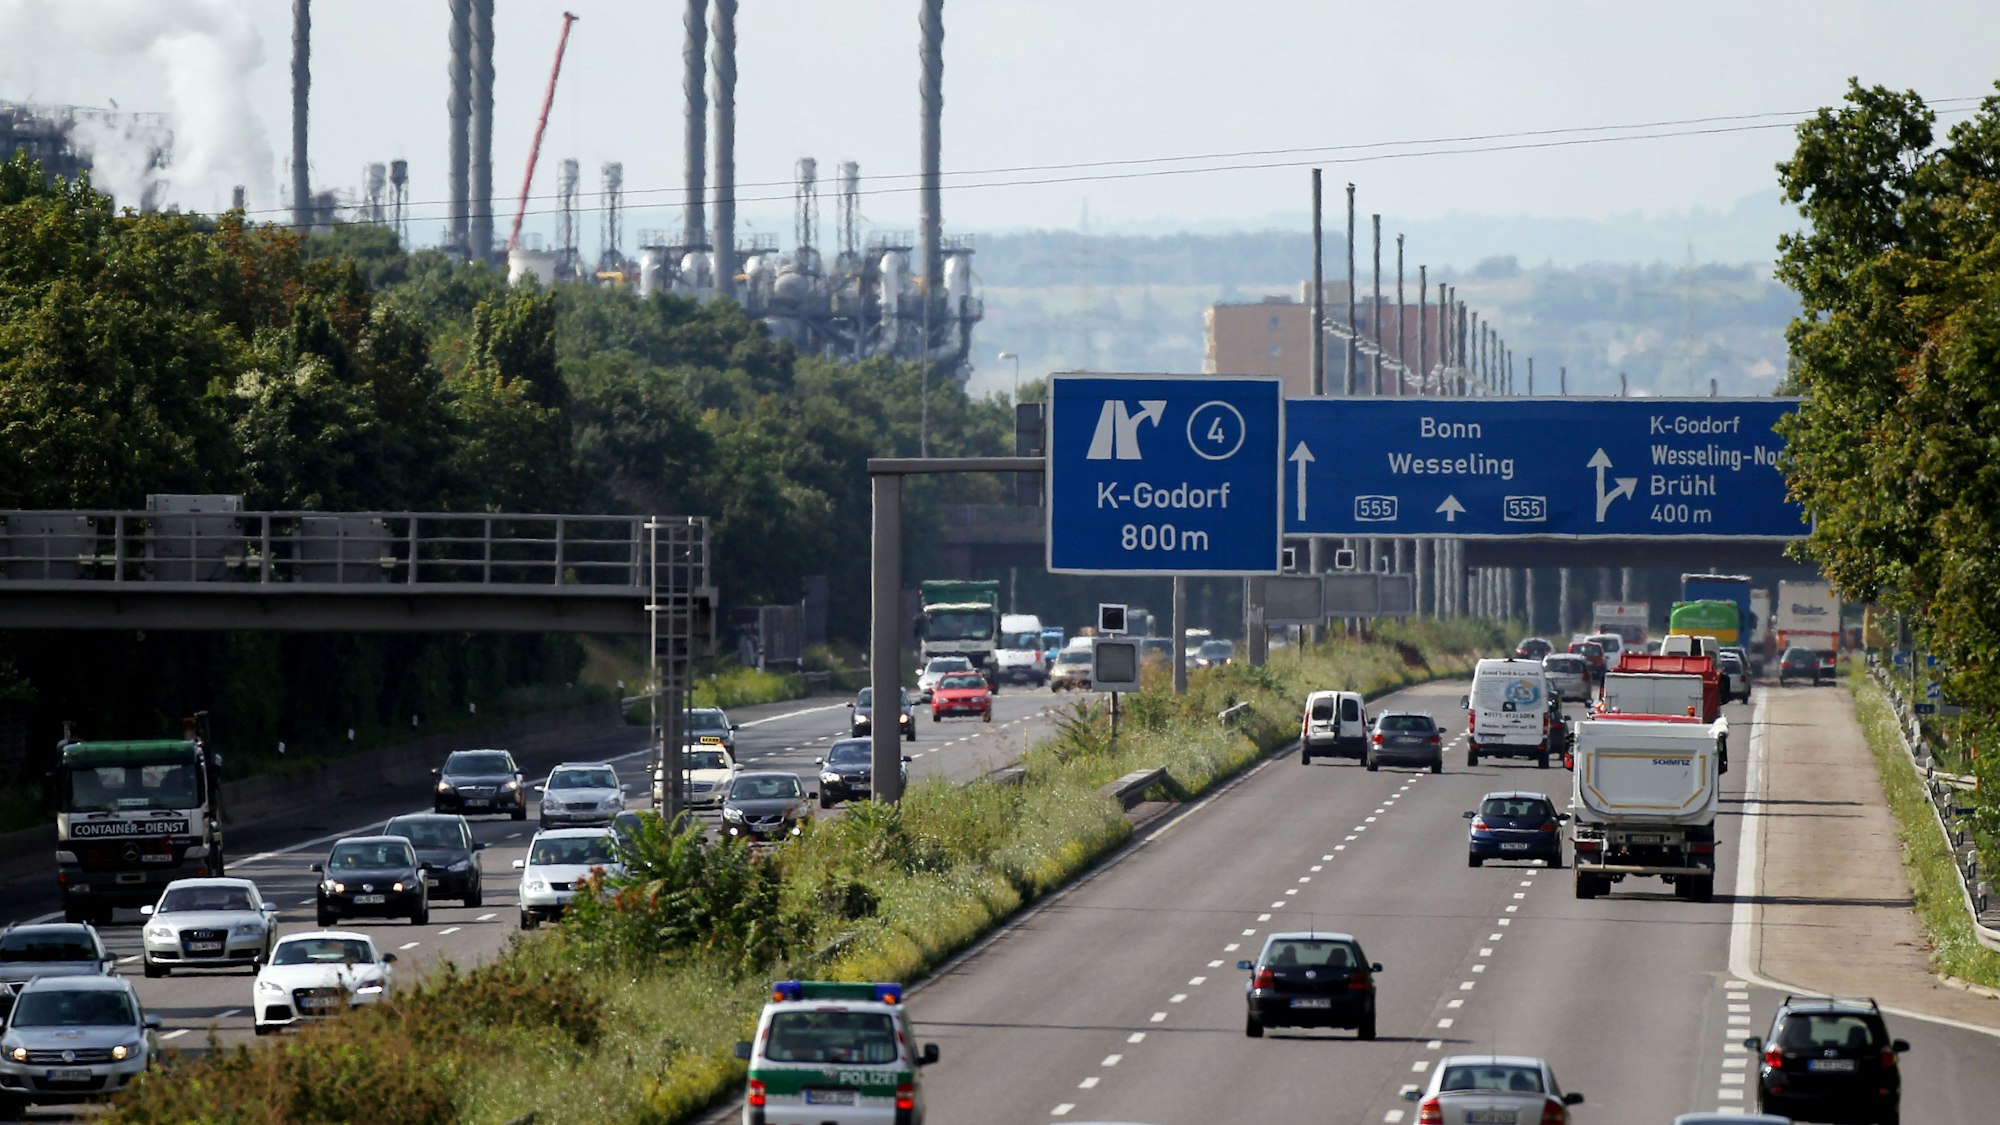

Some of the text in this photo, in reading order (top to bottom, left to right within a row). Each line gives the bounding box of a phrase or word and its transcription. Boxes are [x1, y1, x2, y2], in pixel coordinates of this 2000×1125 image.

[1207, 416, 1225, 443] 4
[1420, 417, 1482, 438] Bonn
[1650, 415, 1741, 435] K-Godorf
[1387, 453, 1514, 481] Wesseling
[1651, 444, 1784, 472] Wesseling-Nor
[1097, 481, 1231, 509] K-Godorf
[1650, 474, 1717, 496] Brühl
[1360, 500, 1392, 517] 555
[1509, 500, 1541, 517] 555
[1650, 503, 1712, 523] 400 m
[1121, 523, 1209, 551] 800 m
[75, 822, 185, 836] CONTAINER-DIENST
[839, 1070, 898, 1085] POLIZEI
